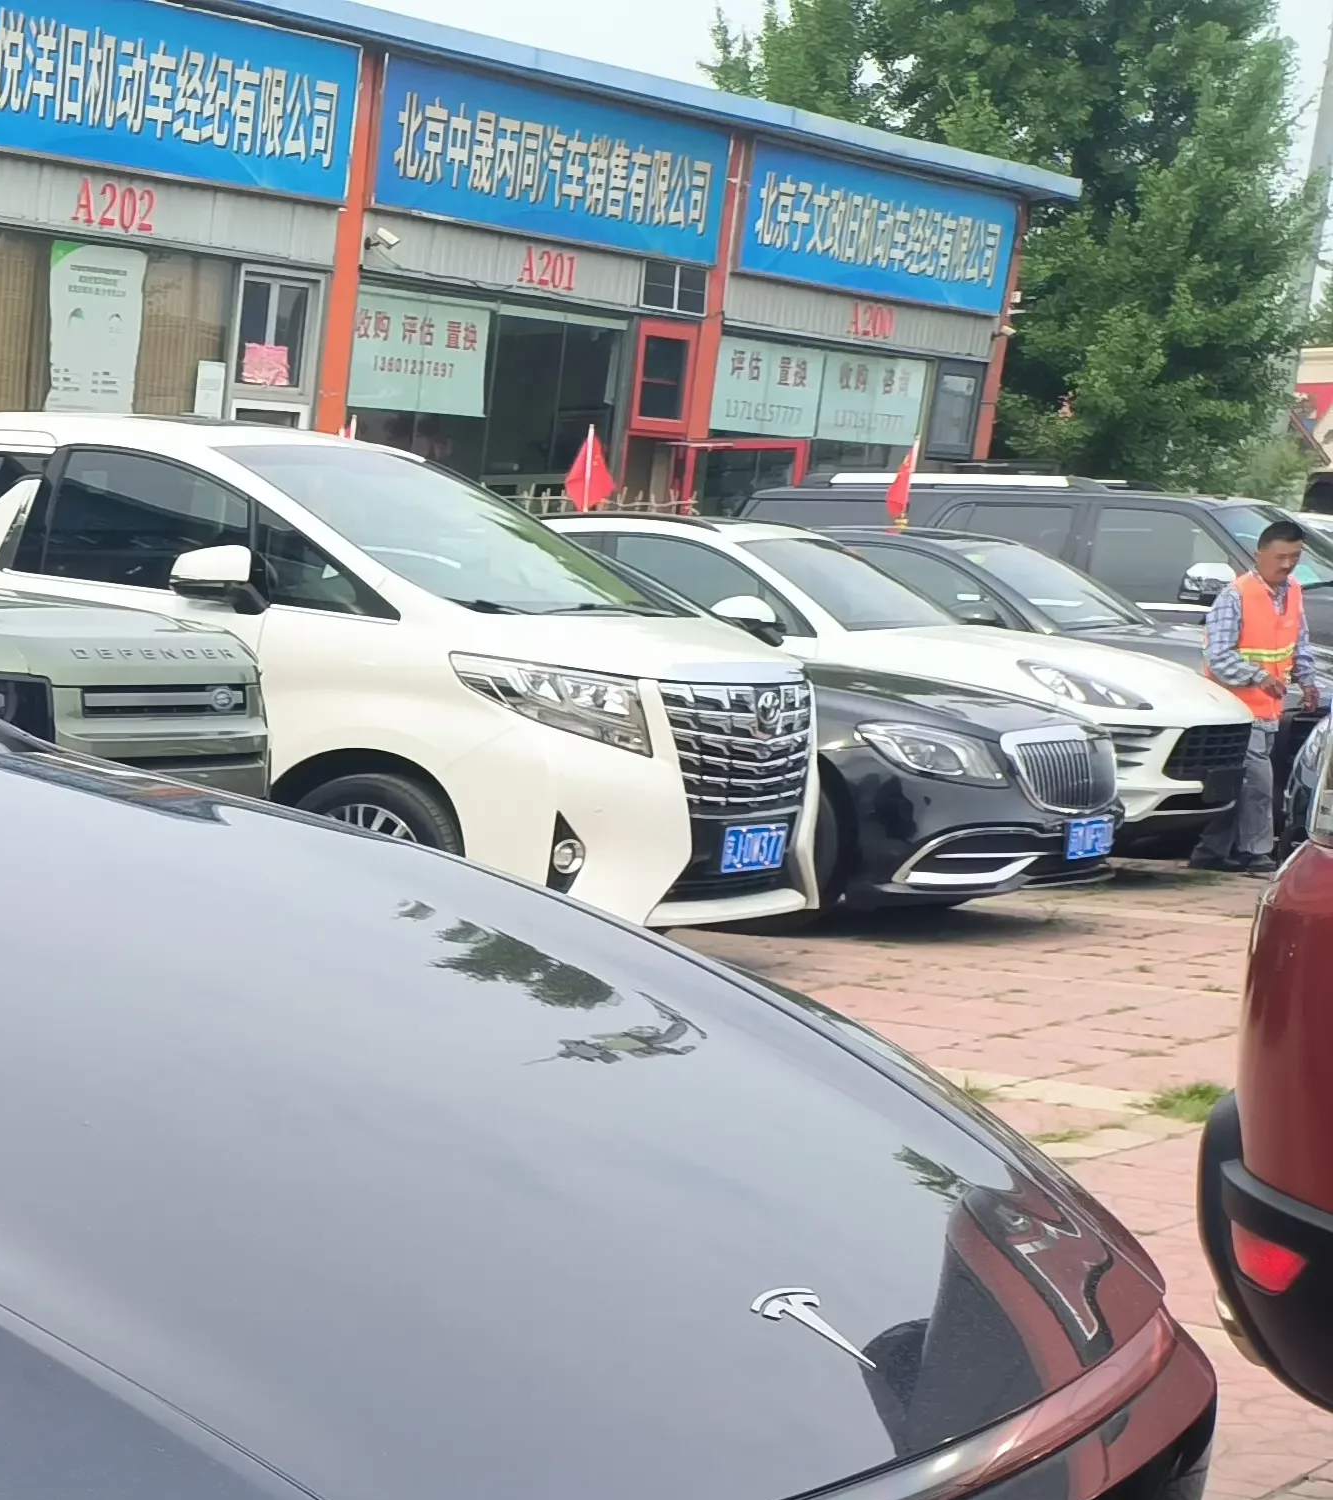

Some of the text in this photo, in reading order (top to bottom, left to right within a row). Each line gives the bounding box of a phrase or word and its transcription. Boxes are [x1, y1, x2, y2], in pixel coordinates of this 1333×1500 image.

[71, 178, 157, 233] A202
[516, 246, 577, 291] A201
[70, 647, 237, 660] DEFENDER
